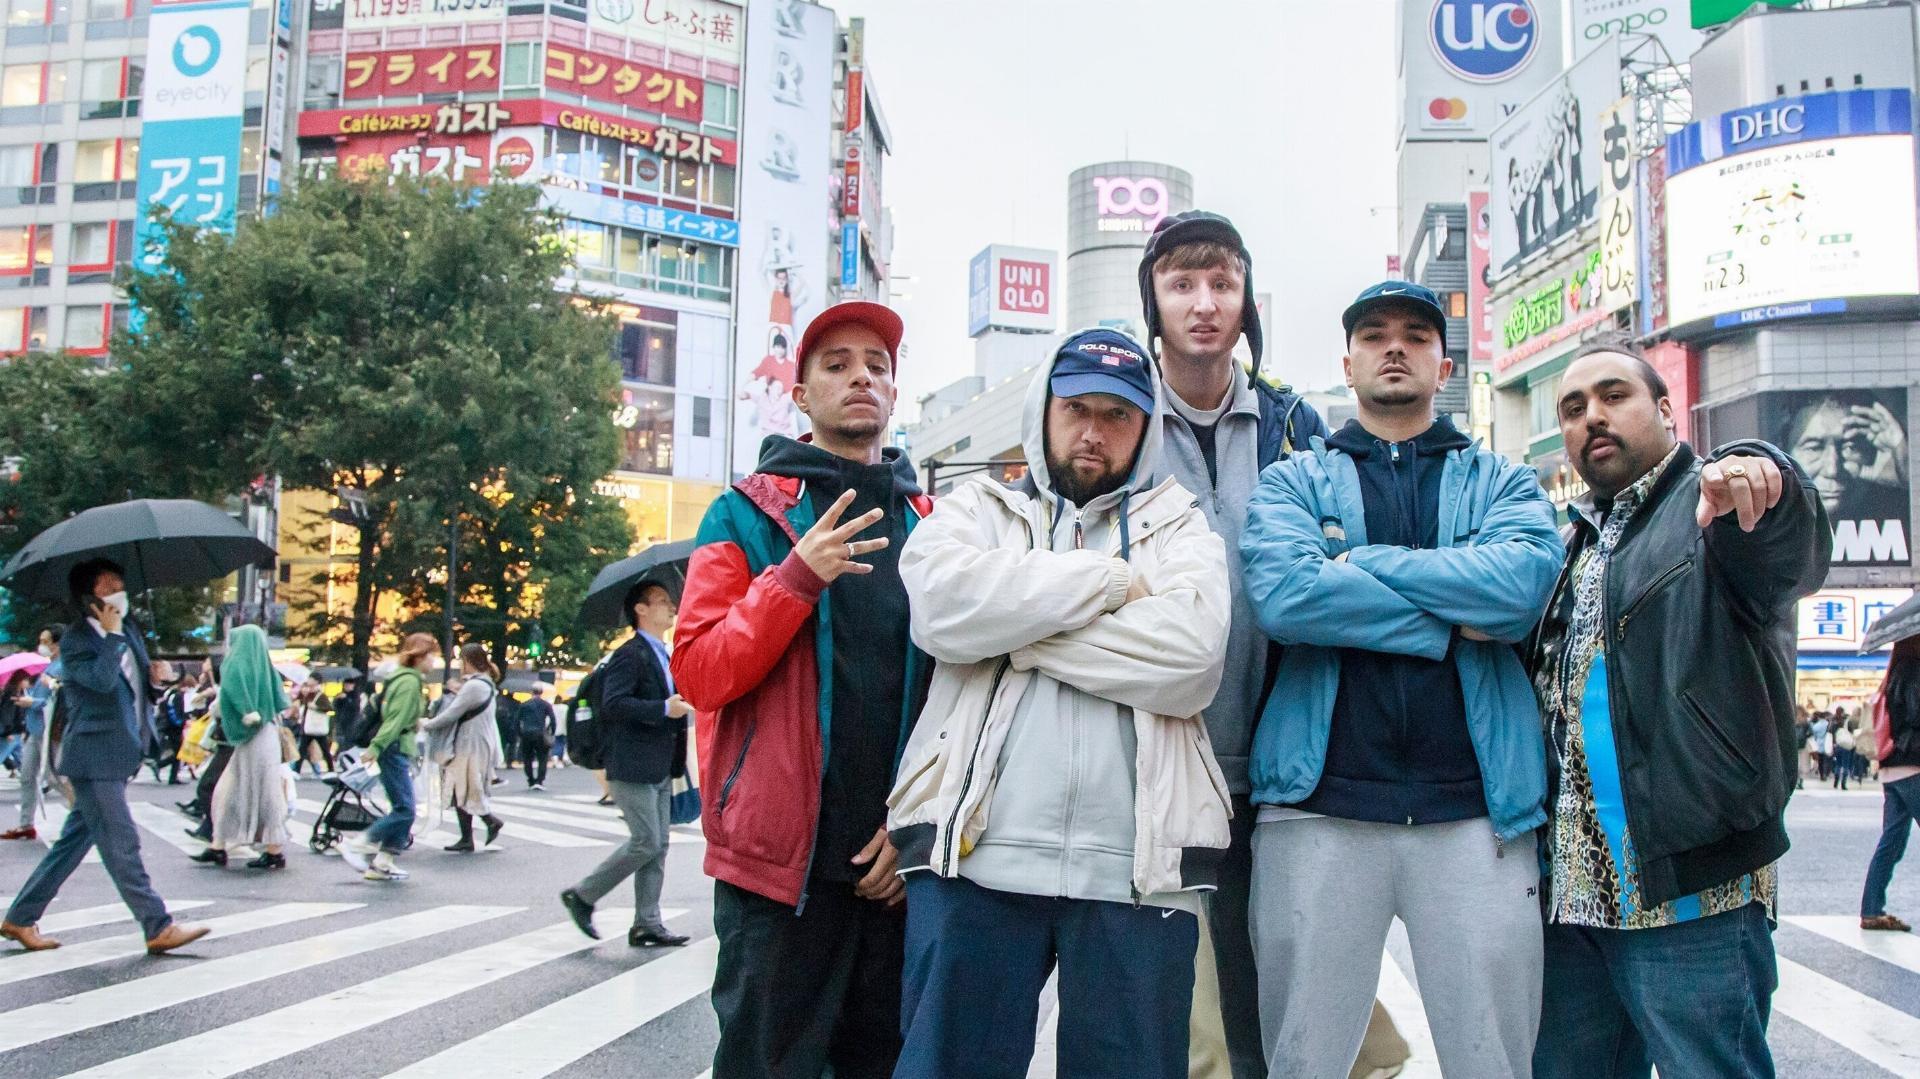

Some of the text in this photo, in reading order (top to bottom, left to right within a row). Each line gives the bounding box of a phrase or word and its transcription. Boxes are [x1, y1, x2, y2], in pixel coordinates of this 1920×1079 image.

[347, 49, 496, 88] プライス
[546, 48, 698, 108] コンタクト
[156, 82, 232, 107] eyecity
[435, 102, 510, 133] ガスト
[1731, 104, 1805, 145] DHC
[653, 127, 723, 165] ガスト
[387, 145, 482, 186] ガスト
[1093, 176, 1168, 230] 109
[1004, 264, 1042, 287] UNI
[1004, 287, 1045, 309] QLO
[1766, 302, 1812, 318] Channel
[1110, 346, 1143, 362] SPORT
